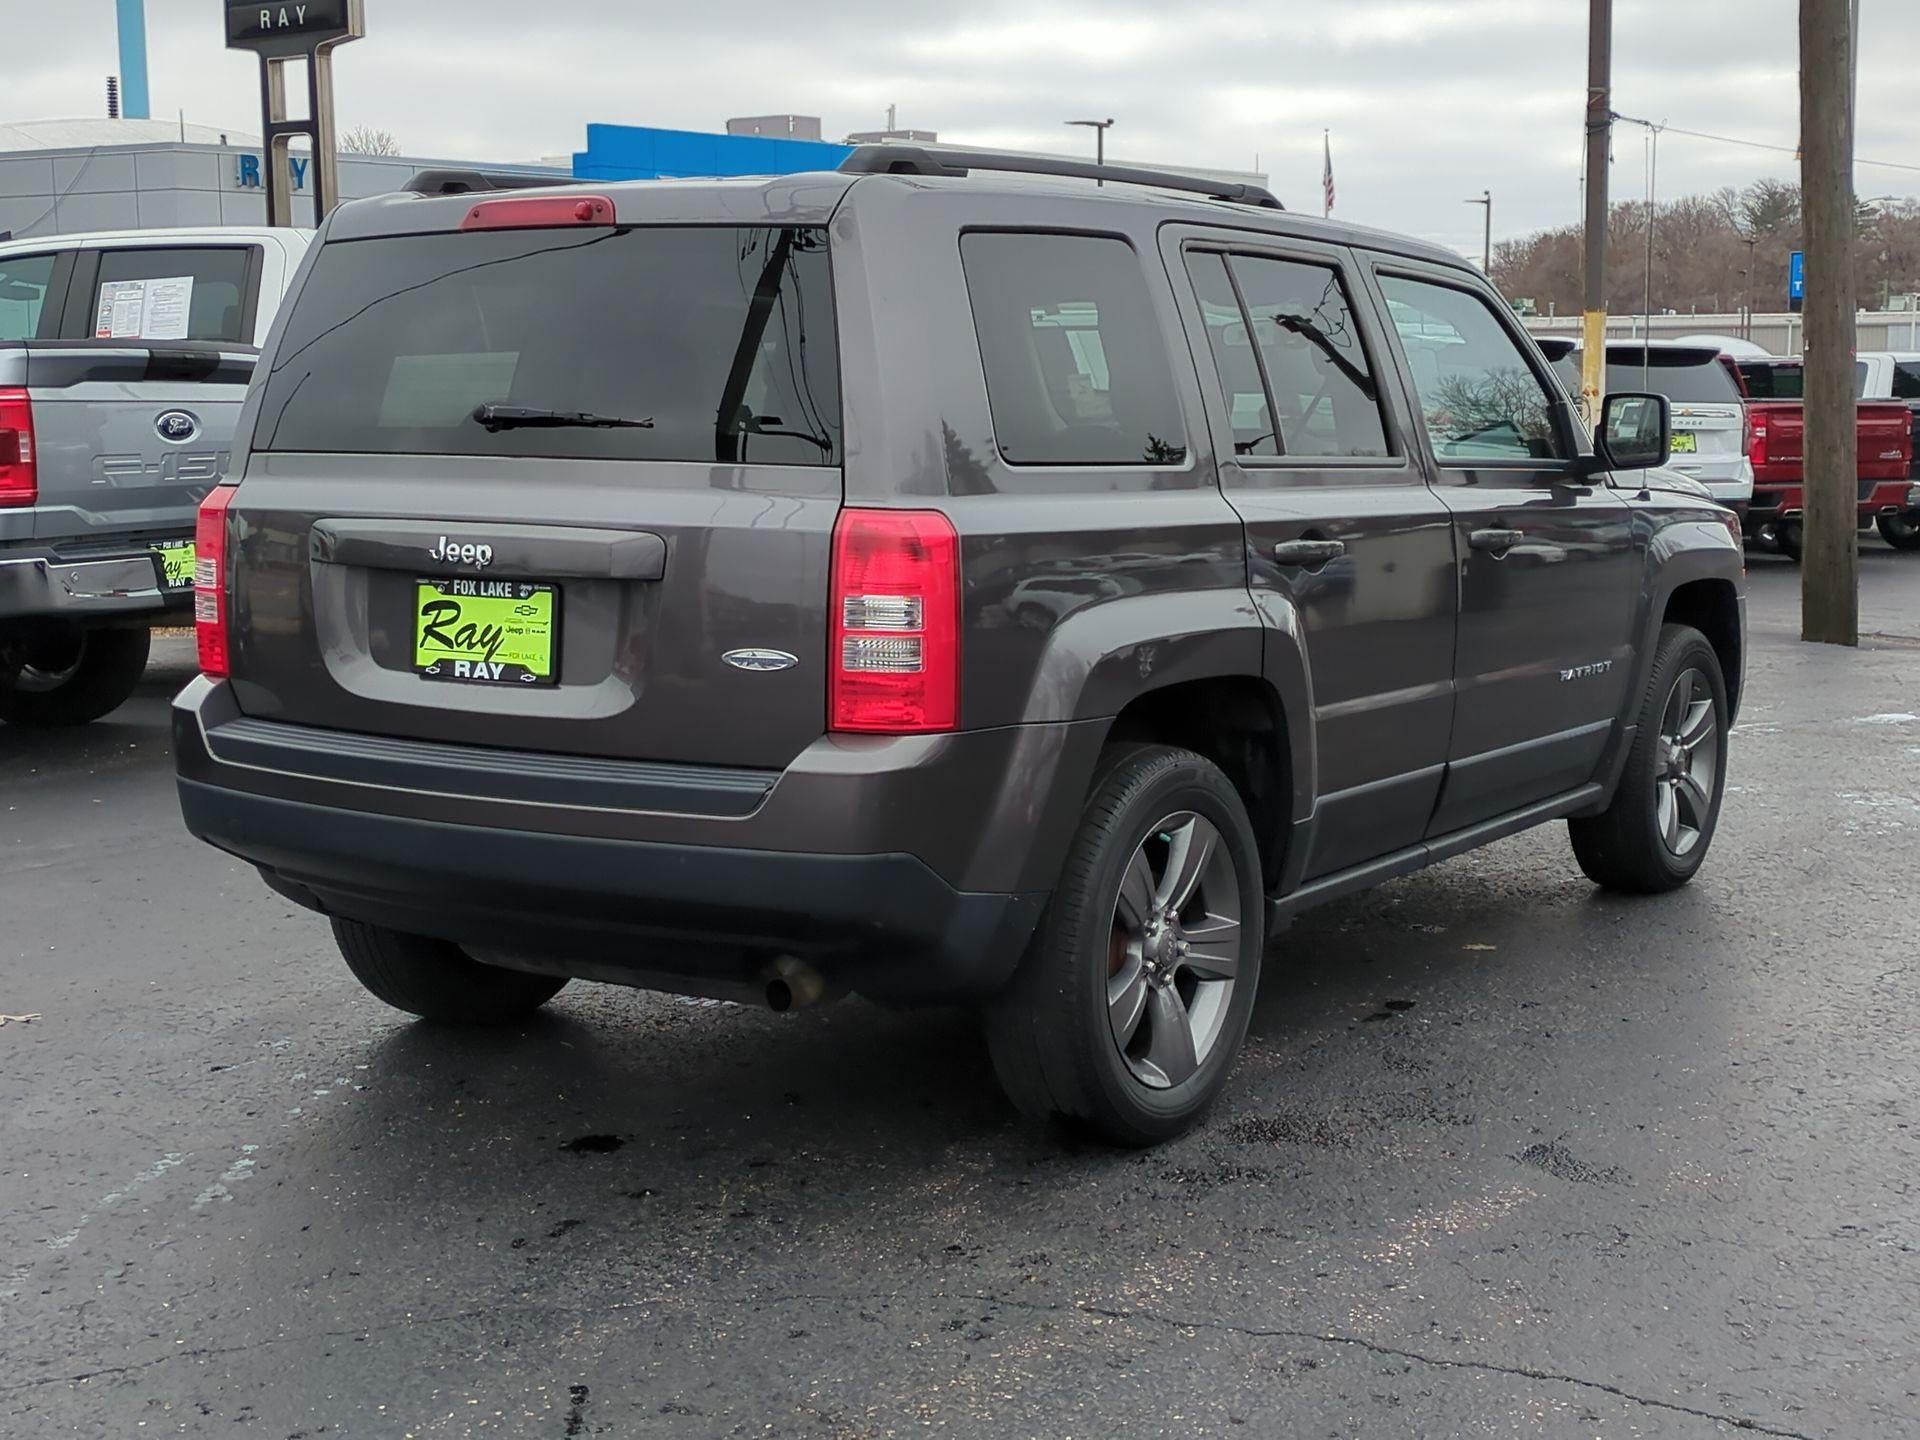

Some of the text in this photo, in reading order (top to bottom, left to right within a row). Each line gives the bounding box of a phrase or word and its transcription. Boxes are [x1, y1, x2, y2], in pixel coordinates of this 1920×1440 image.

[260, 5, 306, 29] RAY
[237, 154, 308, 190] RY
[168, 417, 190, 434] Ford
[429, 536, 494, 570] Jeep
[168, 577, 186, 587] RAY
[453, 580, 478, 596] FOX
[480, 582, 512, 597] LAKE
[419, 600, 505, 662] Ray
[454, 661, 505, 681] RAY
[1559, 660, 1612, 682] PATRIOT
